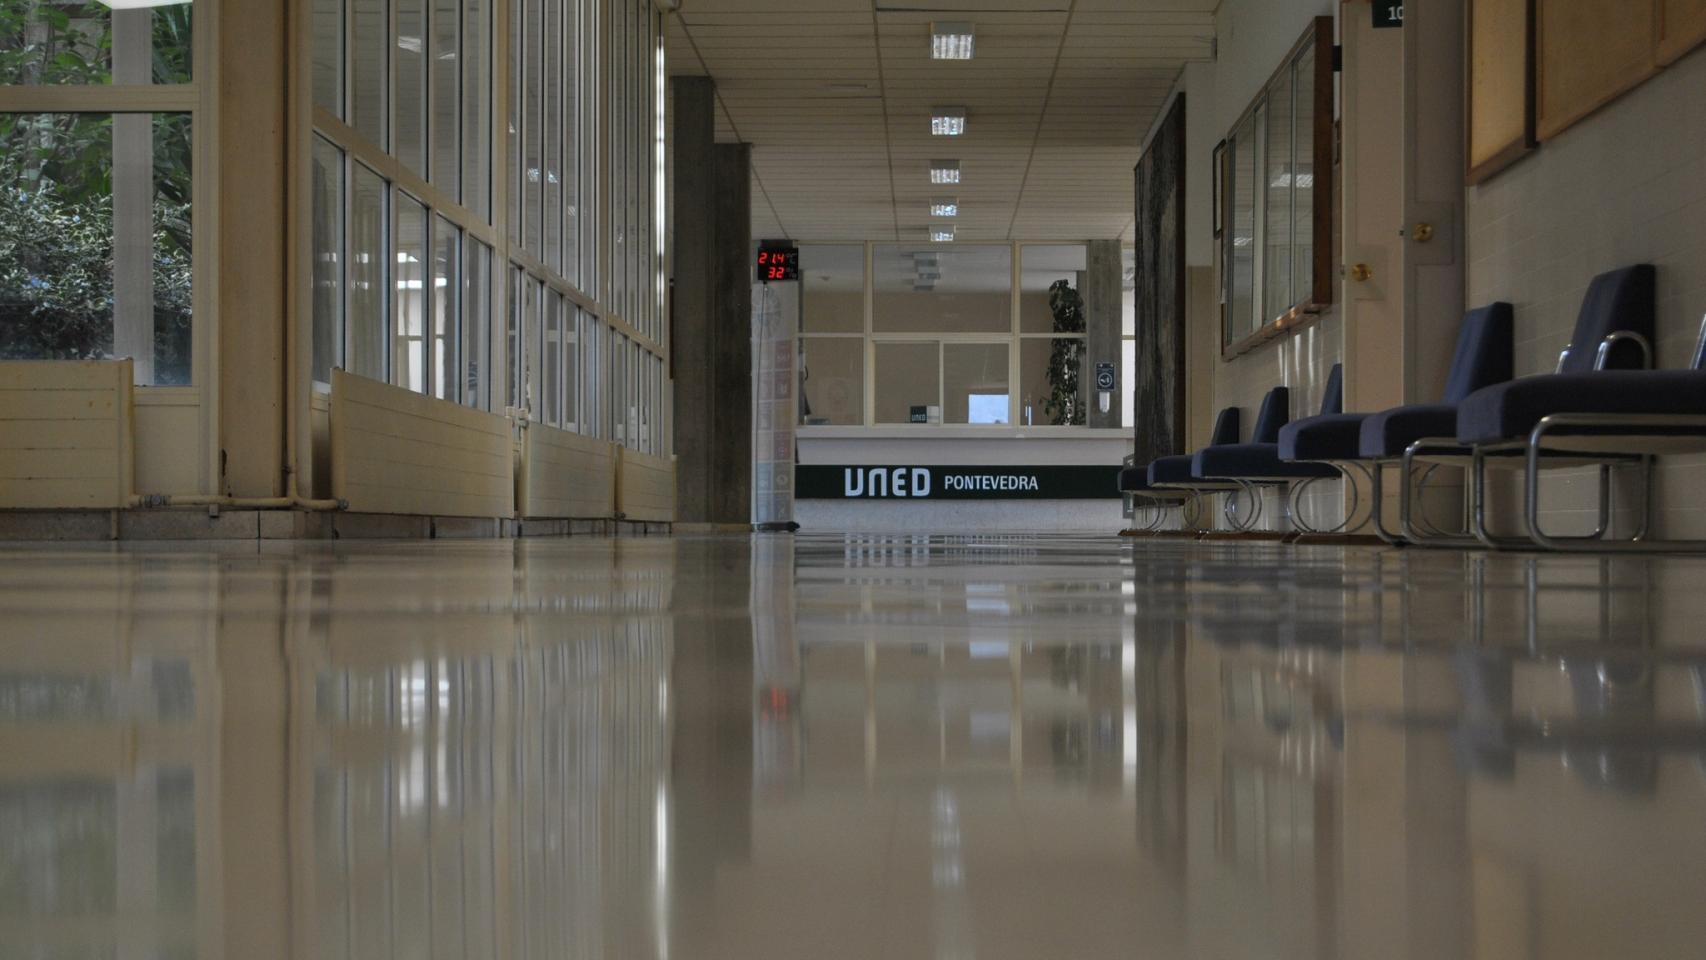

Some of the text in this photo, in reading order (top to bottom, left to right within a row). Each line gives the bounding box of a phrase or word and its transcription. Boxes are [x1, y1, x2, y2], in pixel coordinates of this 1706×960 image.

[768, 266, 785, 279] 32
[844, 468, 1039, 497] UNED PONTEVEDRA
